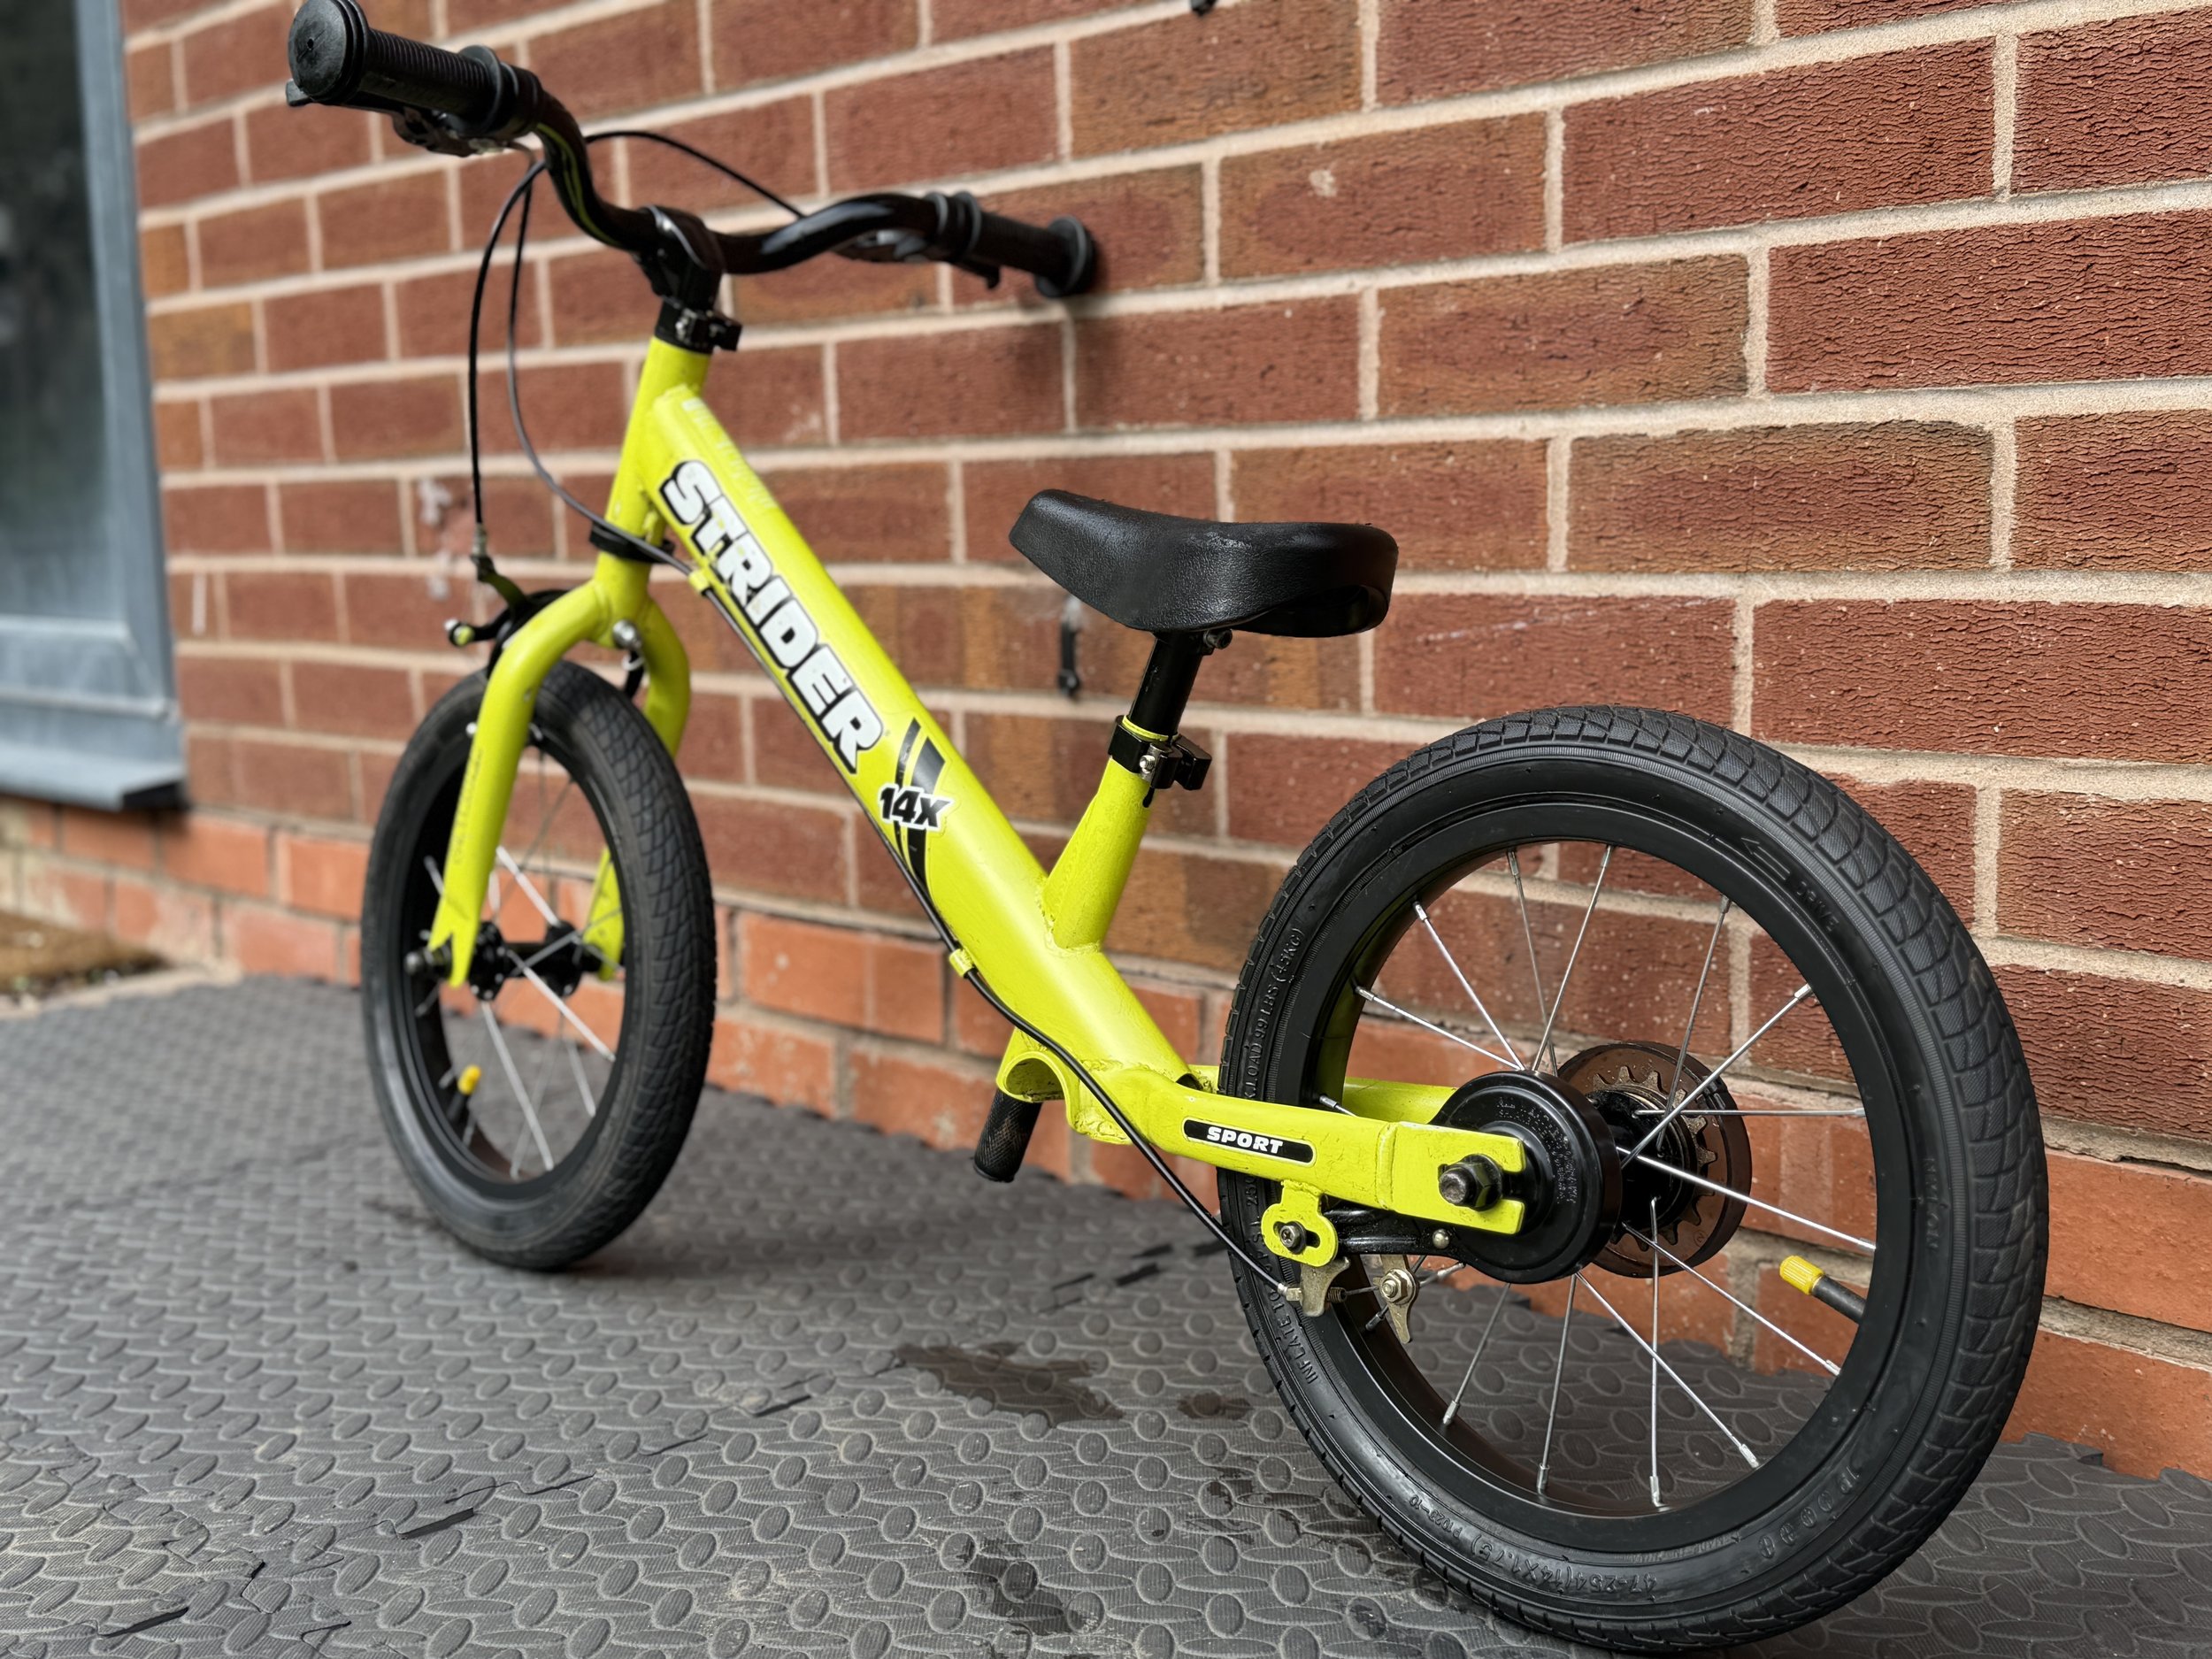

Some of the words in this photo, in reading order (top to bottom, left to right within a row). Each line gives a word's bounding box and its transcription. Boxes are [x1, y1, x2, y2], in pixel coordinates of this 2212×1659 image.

[659, 460, 883, 774] STRIDER
[1255, 1018, 1268, 1039] 99
[1207, 1126, 1283, 1154] SPORT
[1279, 1315, 1318, 1384] INFLATE
